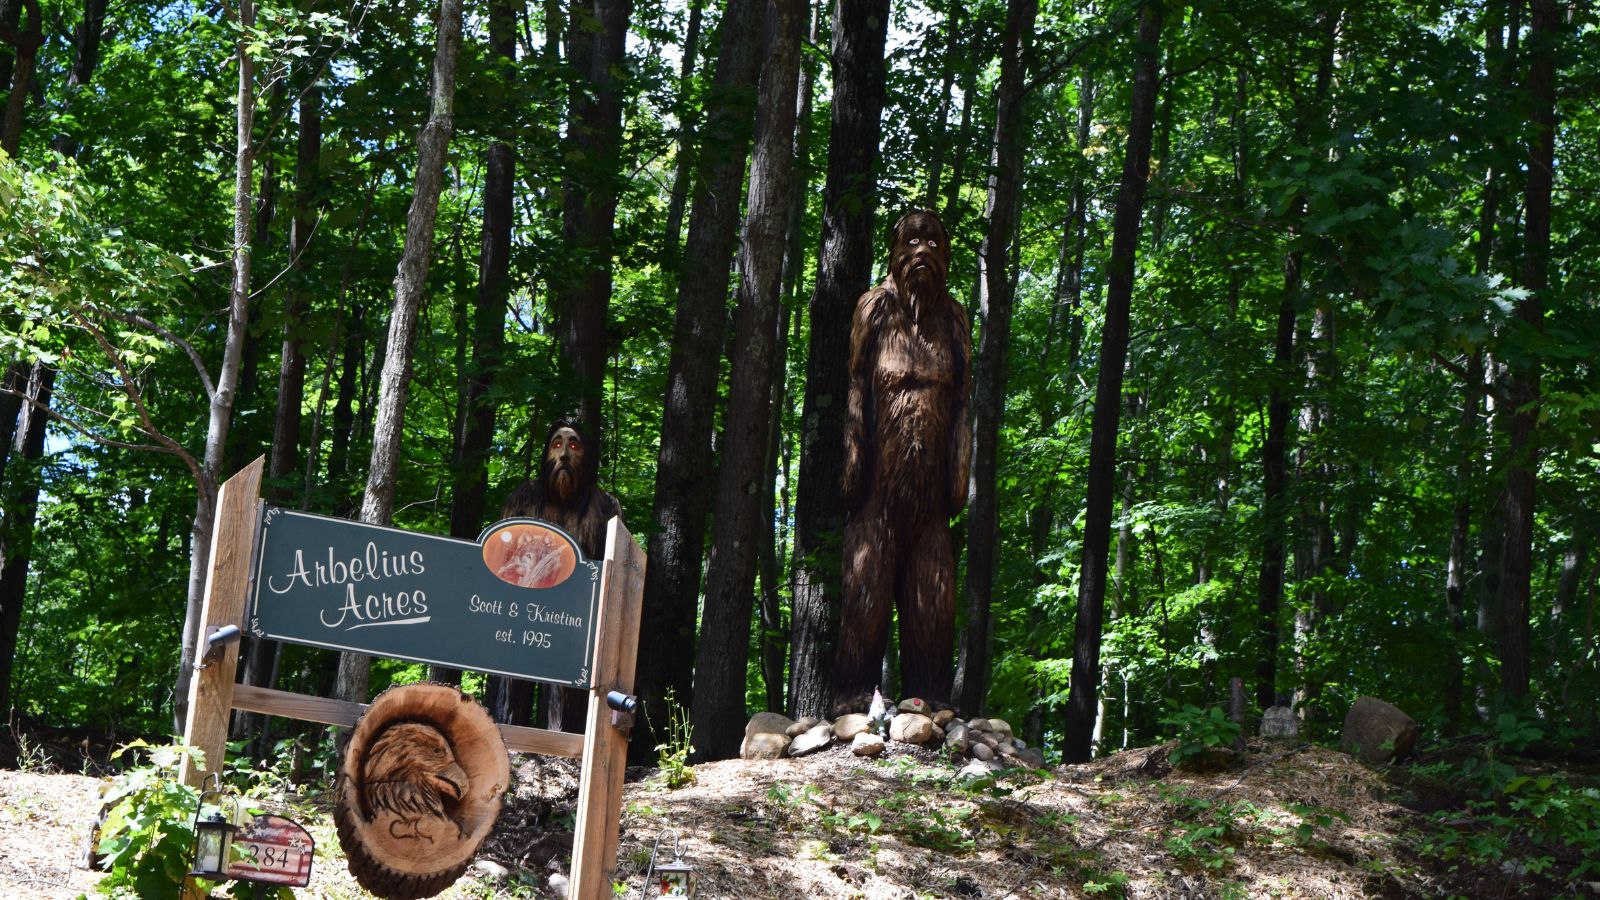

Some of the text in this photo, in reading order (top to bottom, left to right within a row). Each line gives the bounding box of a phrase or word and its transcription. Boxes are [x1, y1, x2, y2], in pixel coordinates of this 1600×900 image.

[268, 541, 426, 595] Arbelius
[320, 582, 429, 628] Acres
[468, 594, 583, 628] Scott & Kristina
[495, 629, 552, 649] est. 1995
